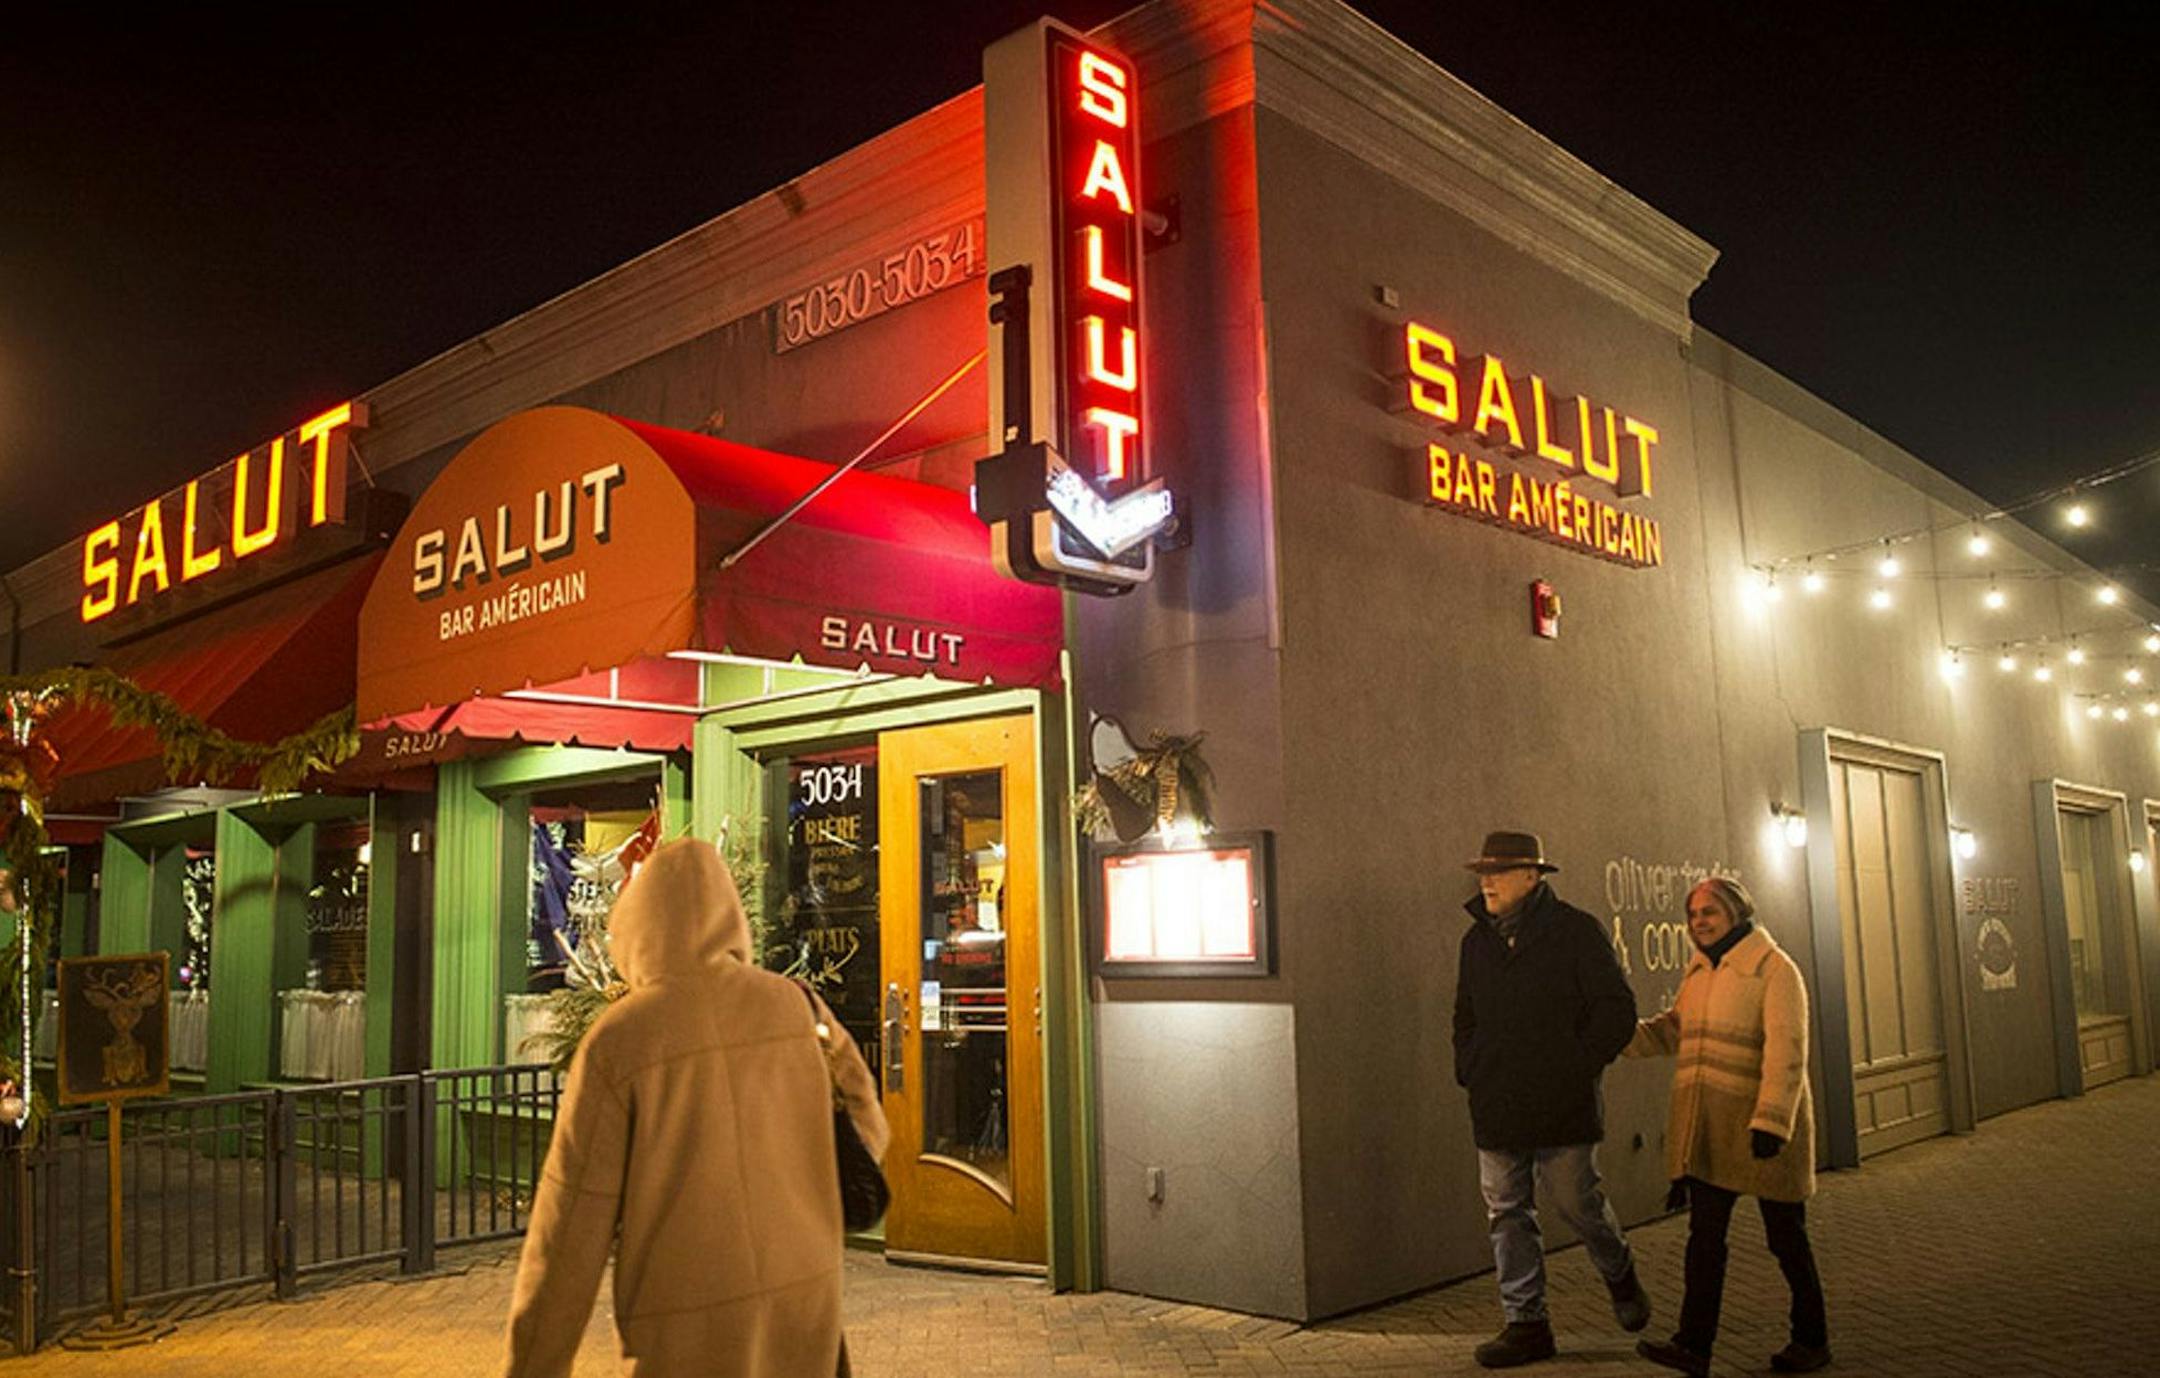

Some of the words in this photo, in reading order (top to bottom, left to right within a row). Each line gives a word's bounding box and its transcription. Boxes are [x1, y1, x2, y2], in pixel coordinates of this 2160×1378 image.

[784, 223, 976, 343] 5030-5034
[1079, 50, 1139, 480] SALUT
[1406, 321, 1660, 499] SALUT
[80, 402, 352, 622] SALUT
[413, 463, 622, 596] SALUT
[1428, 442, 1499, 516] BAR
[1508, 471, 1663, 567] AMÉRICAIN
[440, 605, 475, 641] BAR
[479, 570, 587, 630] AMÉRICAIN
[821, 616, 964, 664] SALUT
[800, 763, 863, 807] 5034
